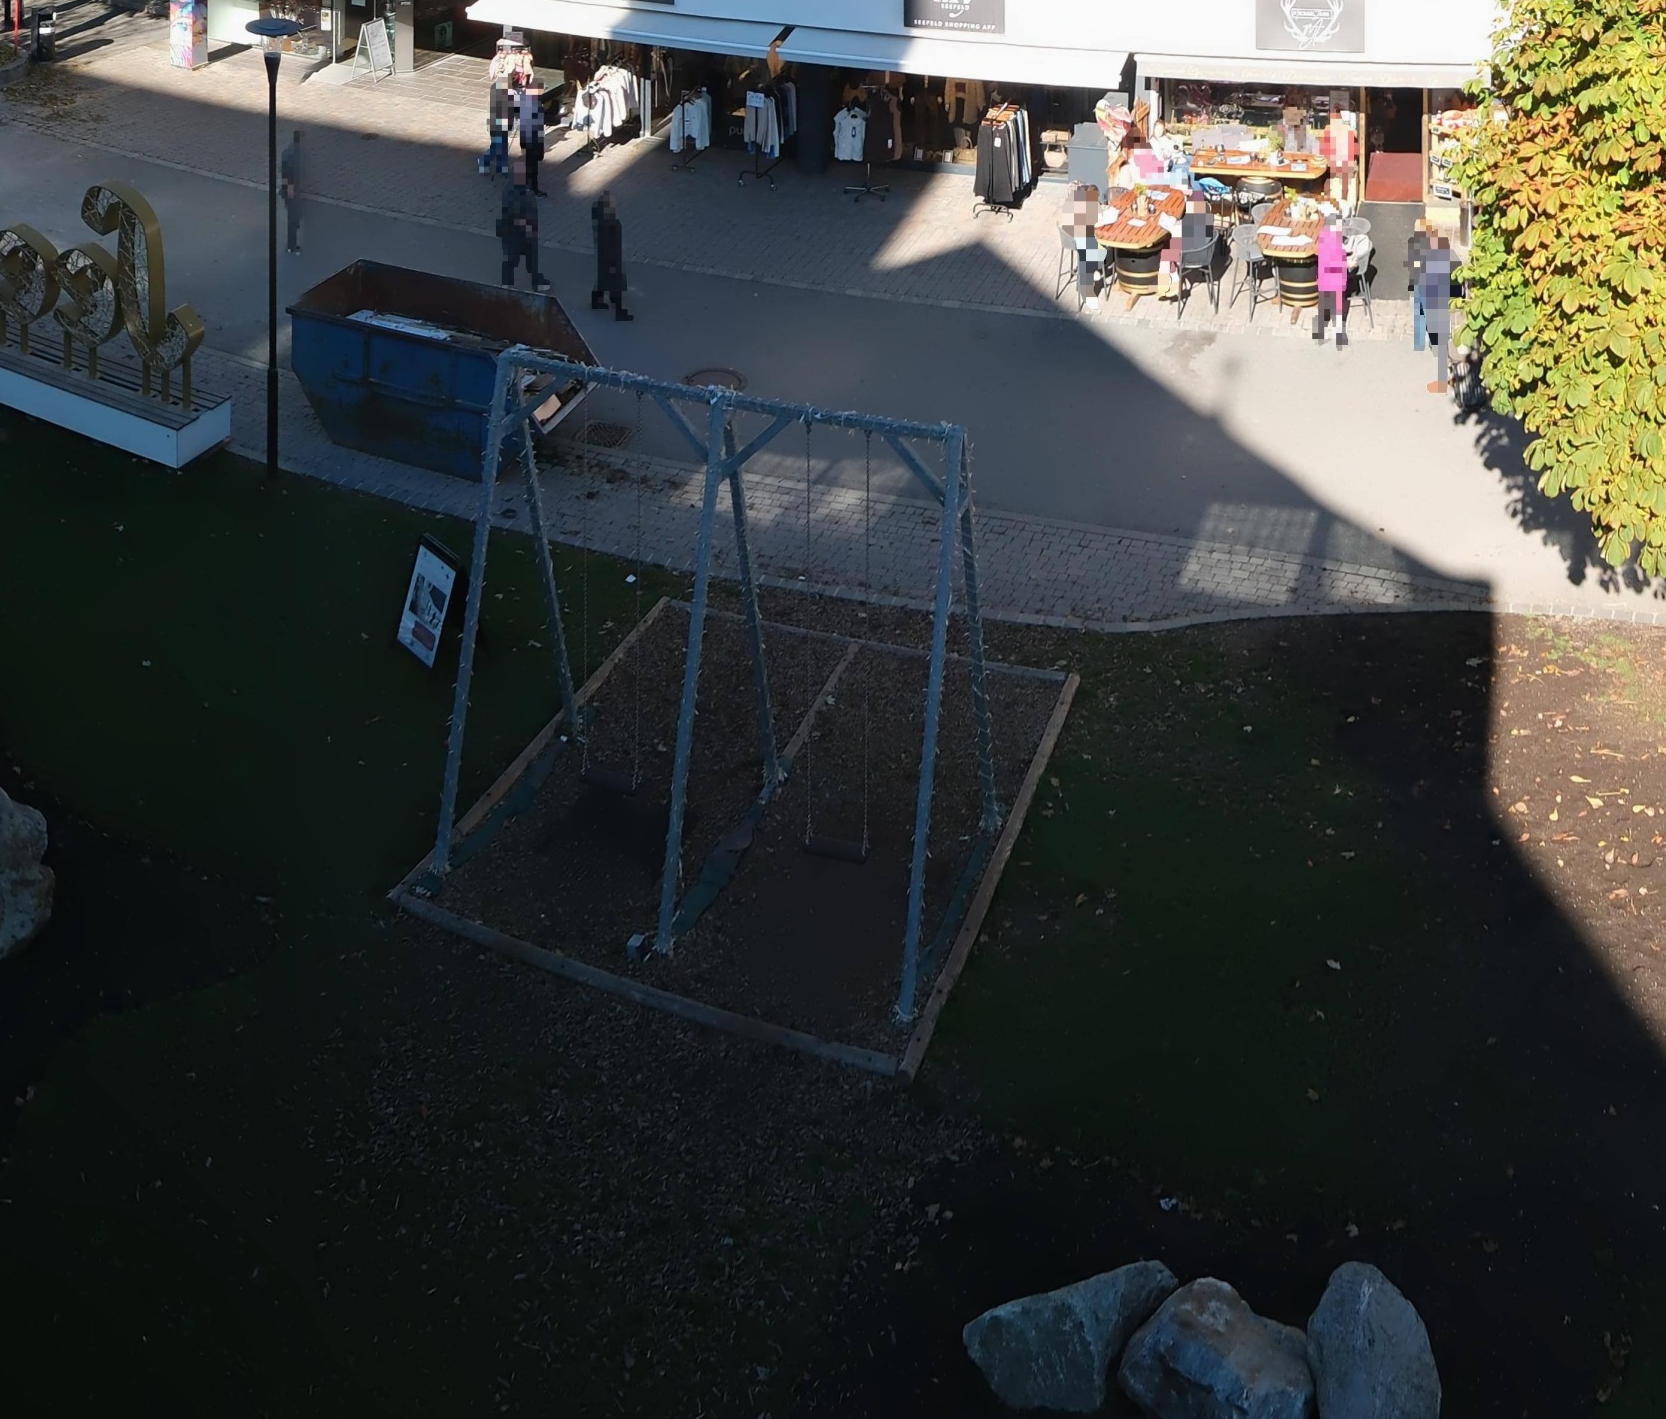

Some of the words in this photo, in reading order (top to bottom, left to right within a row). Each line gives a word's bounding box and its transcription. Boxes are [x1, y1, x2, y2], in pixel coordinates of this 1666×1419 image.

[940, 2, 970, 11] SEEFELD
[913, 19, 943, 28] SEEFELD
[944, 21, 981, 30] SHOPPING
